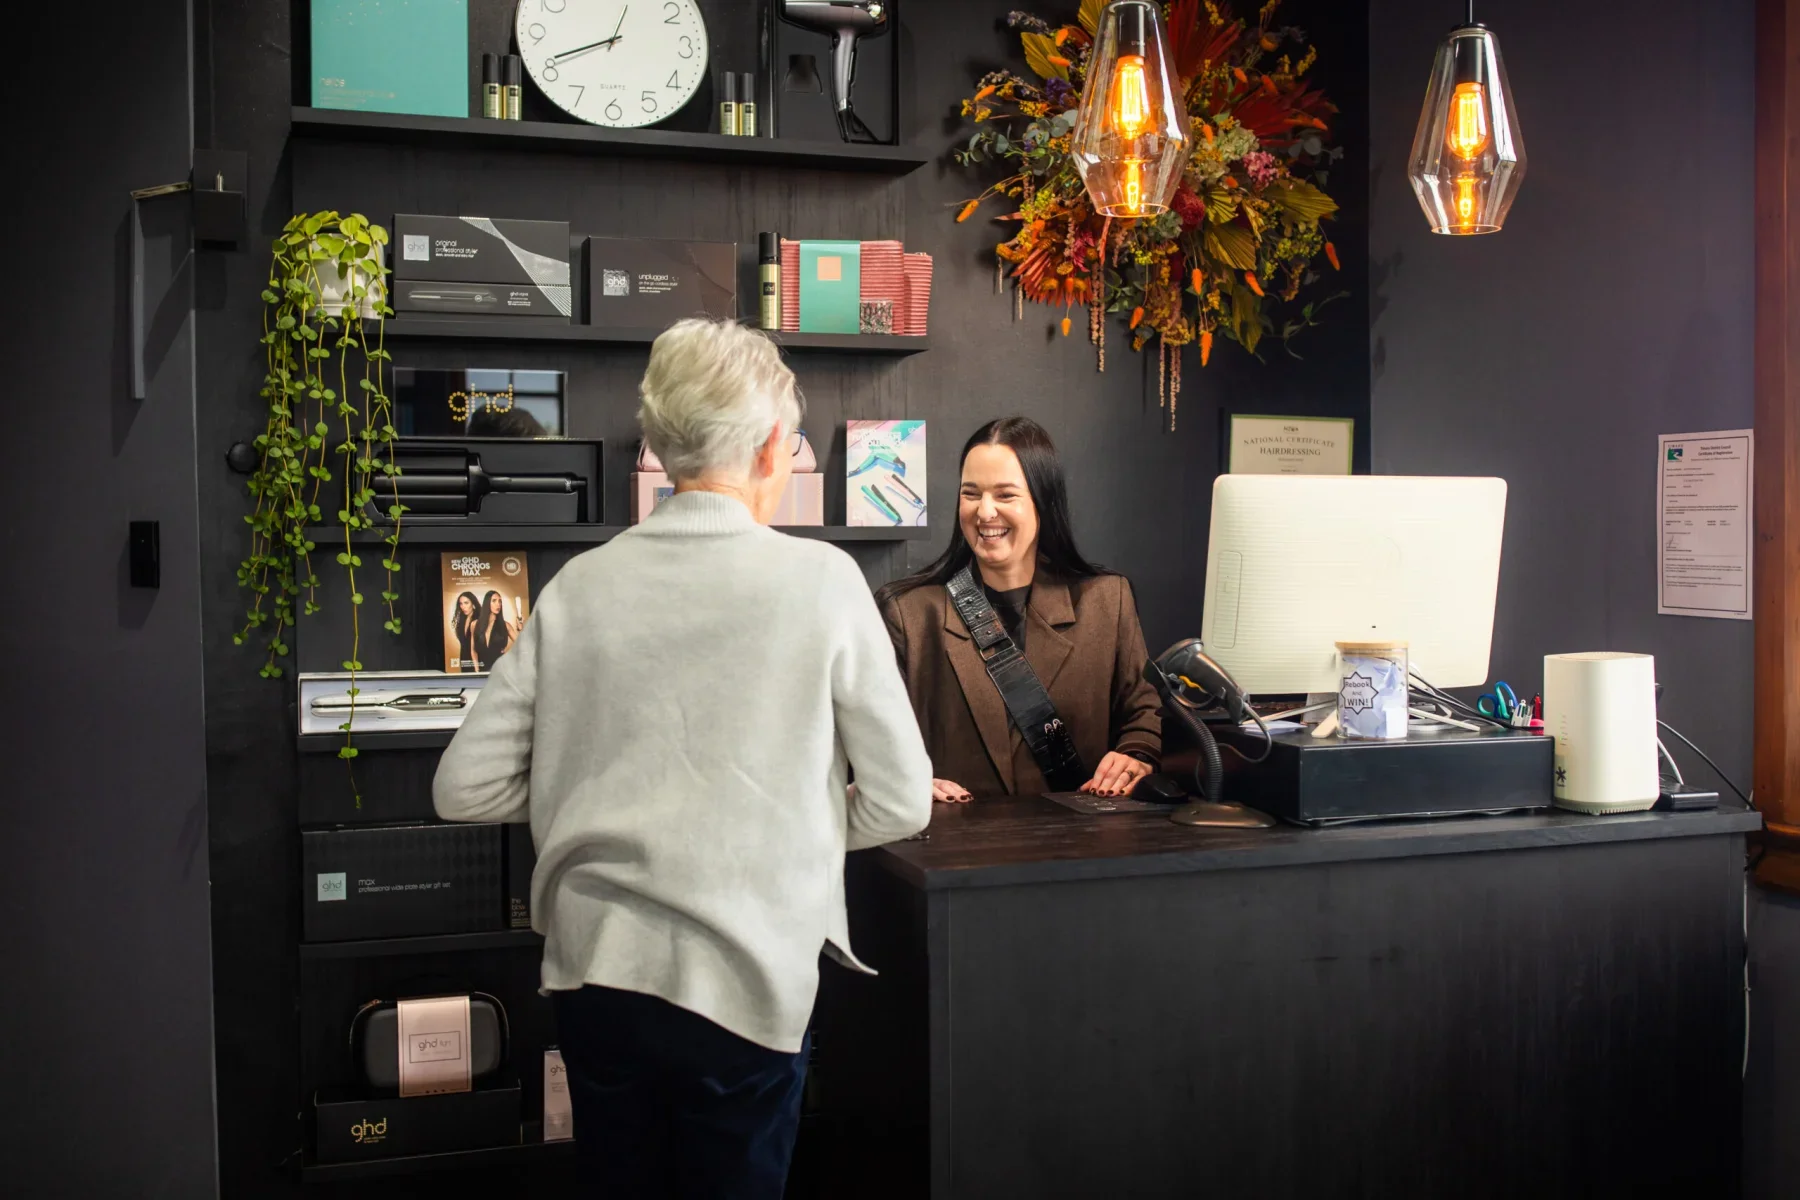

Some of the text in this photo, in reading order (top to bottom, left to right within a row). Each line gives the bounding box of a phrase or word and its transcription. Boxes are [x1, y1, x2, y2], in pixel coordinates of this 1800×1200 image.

[664, 2, 681, 24] 2
[528, 23, 546, 46] 9
[678, 36, 694, 59] 3
[542, 58, 559, 82] 8
[600, 83, 627, 91] QUARTZ
[666, 69, 682, 91] 4
[568, 84, 585, 107] 7
[641, 90, 658, 113] 5
[604, 98, 623, 121] 6
[407, 241, 425, 252] ghd
[435, 240, 457, 250] original
[607, 275, 626, 288] ghd
[449, 383, 514, 422] ghd
[1243, 436, 1335, 448] NATIONAL CERTIFICATE
[1259, 447, 1321, 456] HAIRDRESSING
[462, 556, 480, 564] GHD
[1347, 698, 1369, 706] WIN!
[322, 879, 342, 893] ghd
[358, 885, 391, 894] professional
[418, 1038, 438, 1051] ghd
[351, 1117, 387, 1143] ghd
